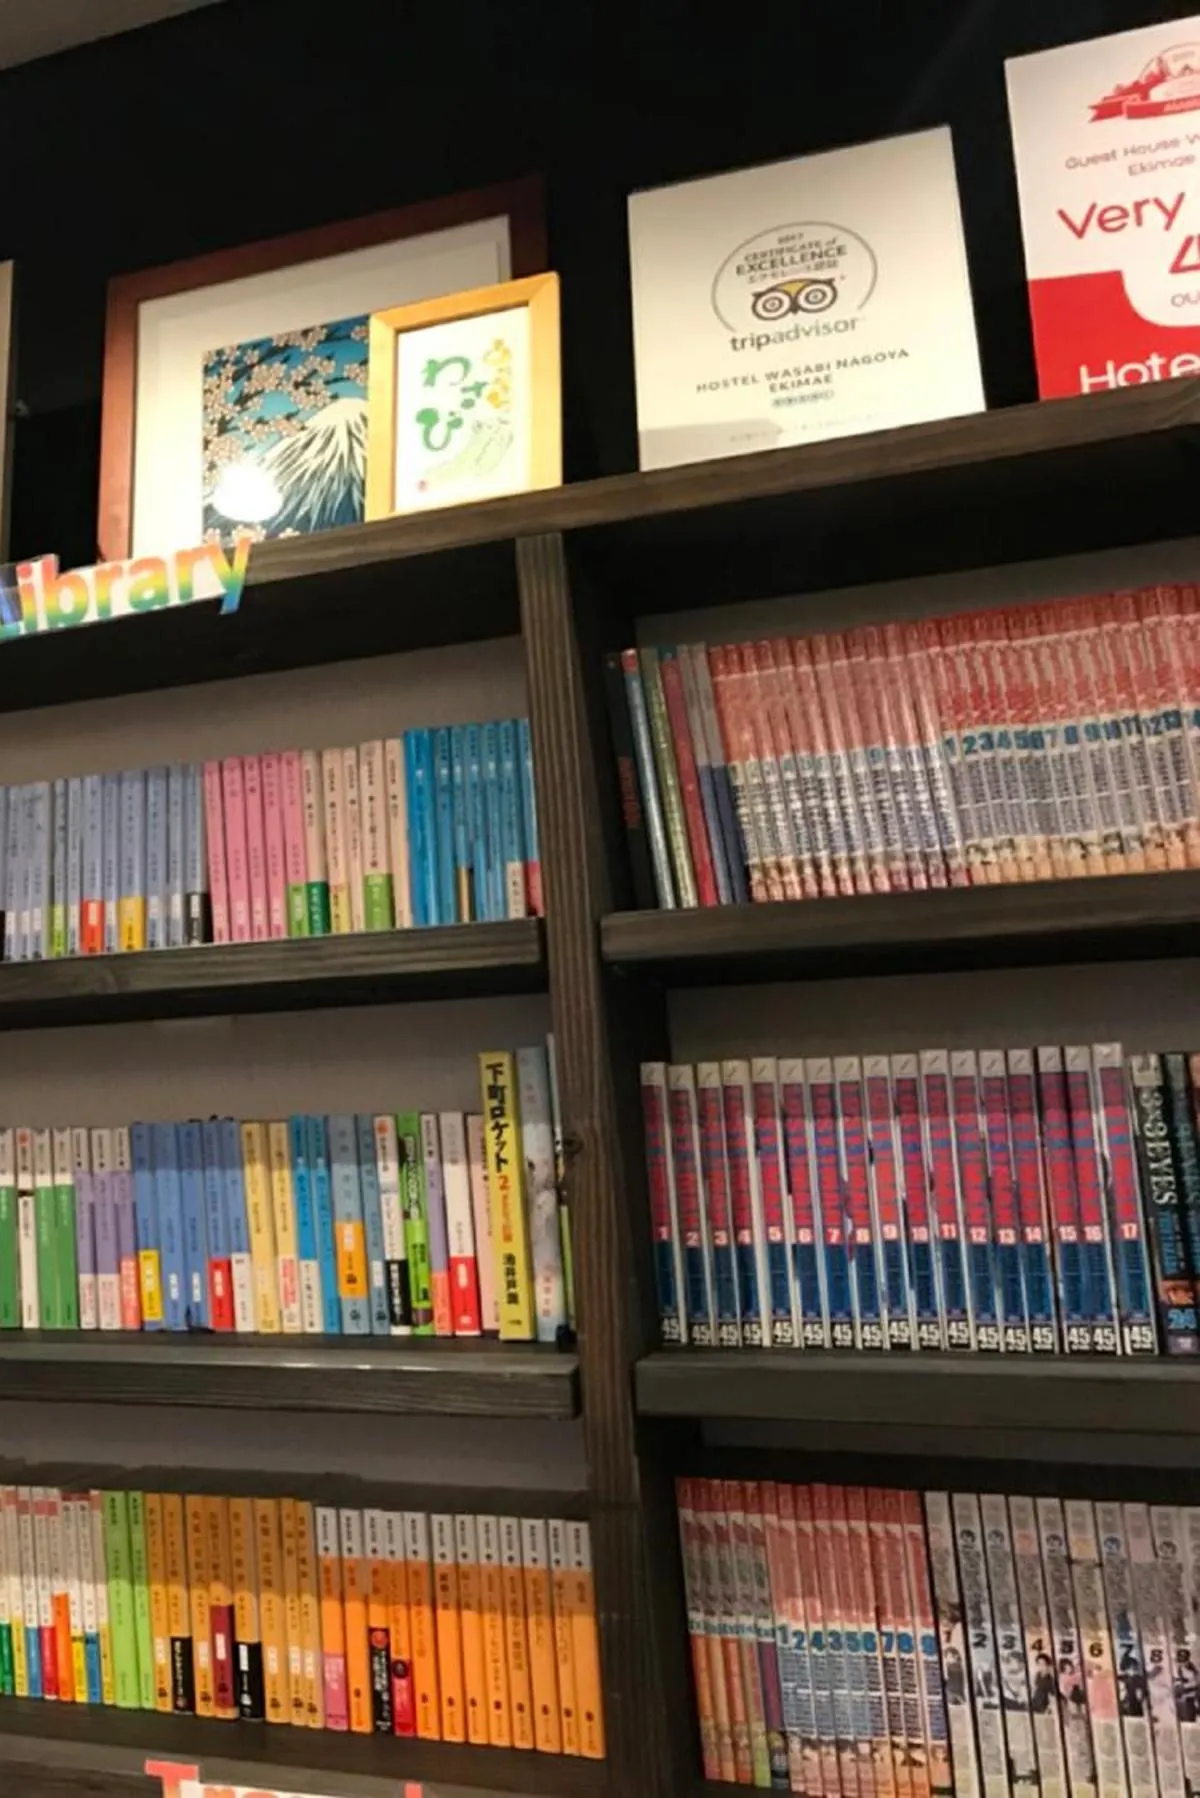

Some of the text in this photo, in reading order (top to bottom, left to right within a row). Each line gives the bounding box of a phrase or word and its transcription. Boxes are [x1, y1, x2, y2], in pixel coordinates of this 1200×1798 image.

[1057, 192, 1186, 239] Very
[744, 240, 822, 262] CERTIFICATE
[736, 244, 848, 276] EXCELLENCE
[729, 317, 858, 352] tripadvisor
[696, 348, 910, 393] HOSTEL WASABI NAGOYA
[1080, 353, 1200, 394] Hote
[769, 374, 833, 393] EKIMAE
[963, 735, 977, 754] 2
[486, 1062, 509, 1173] 下町ロケット
[659, 1227, 669, 1240] 1
[715, 1231, 728, 1245] 3
[738, 1229, 750, 1243] 4
[769, 1227, 781, 1242] 5
[800, 1228, 812, 1242] 6
[828, 1228, 841, 1242] 7
[883, 1224, 897, 1239] 9
[941, 1223, 956, 1239] 11
[970, 1227, 986, 1242] 12
[1025, 1227, 1041, 1242] 14
[1059, 1225, 1076, 1241] 15
[1121, 1223, 1137, 1238] 17
[687, 1232, 698, 1246] 2
[661, 1318, 679, 1335] 45
[692, 1325, 711, 1341] 45
[720, 1324, 738, 1340] 45
[744, 1323, 761, 1339] 45
[773, 1321, 792, 1338] 45
[804, 1324, 824, 1340] 45
[833, 1324, 852, 1340] 45
[862, 1325, 882, 1341] 45
[890, 1321, 909, 1337] 45
[918, 1324, 939, 1340] 45
[949, 1321, 969, 1337] 45
[978, 1326, 998, 1343] 45
[1033, 1326, 1052, 1342] 45
[1131, 1326, 1151, 1342] 45
[1006, 1328, 1026, 1345] 45
[1069, 1327, 1090, 1344] 45
[1093, 1327, 1114, 1344] 45
[792, 1630, 805, 1649] 2
[881, 1631, 894, 1652] 7
[973, 1633, 987, 1648] 2
[1003, 1635, 1016, 1649] 3
[1031, 1638, 1044, 1651] 4
[1089, 1643, 1103, 1657] 6
[1150, 1650, 1163, 1664] 8
[1176, 1649, 1190, 1664] 9
